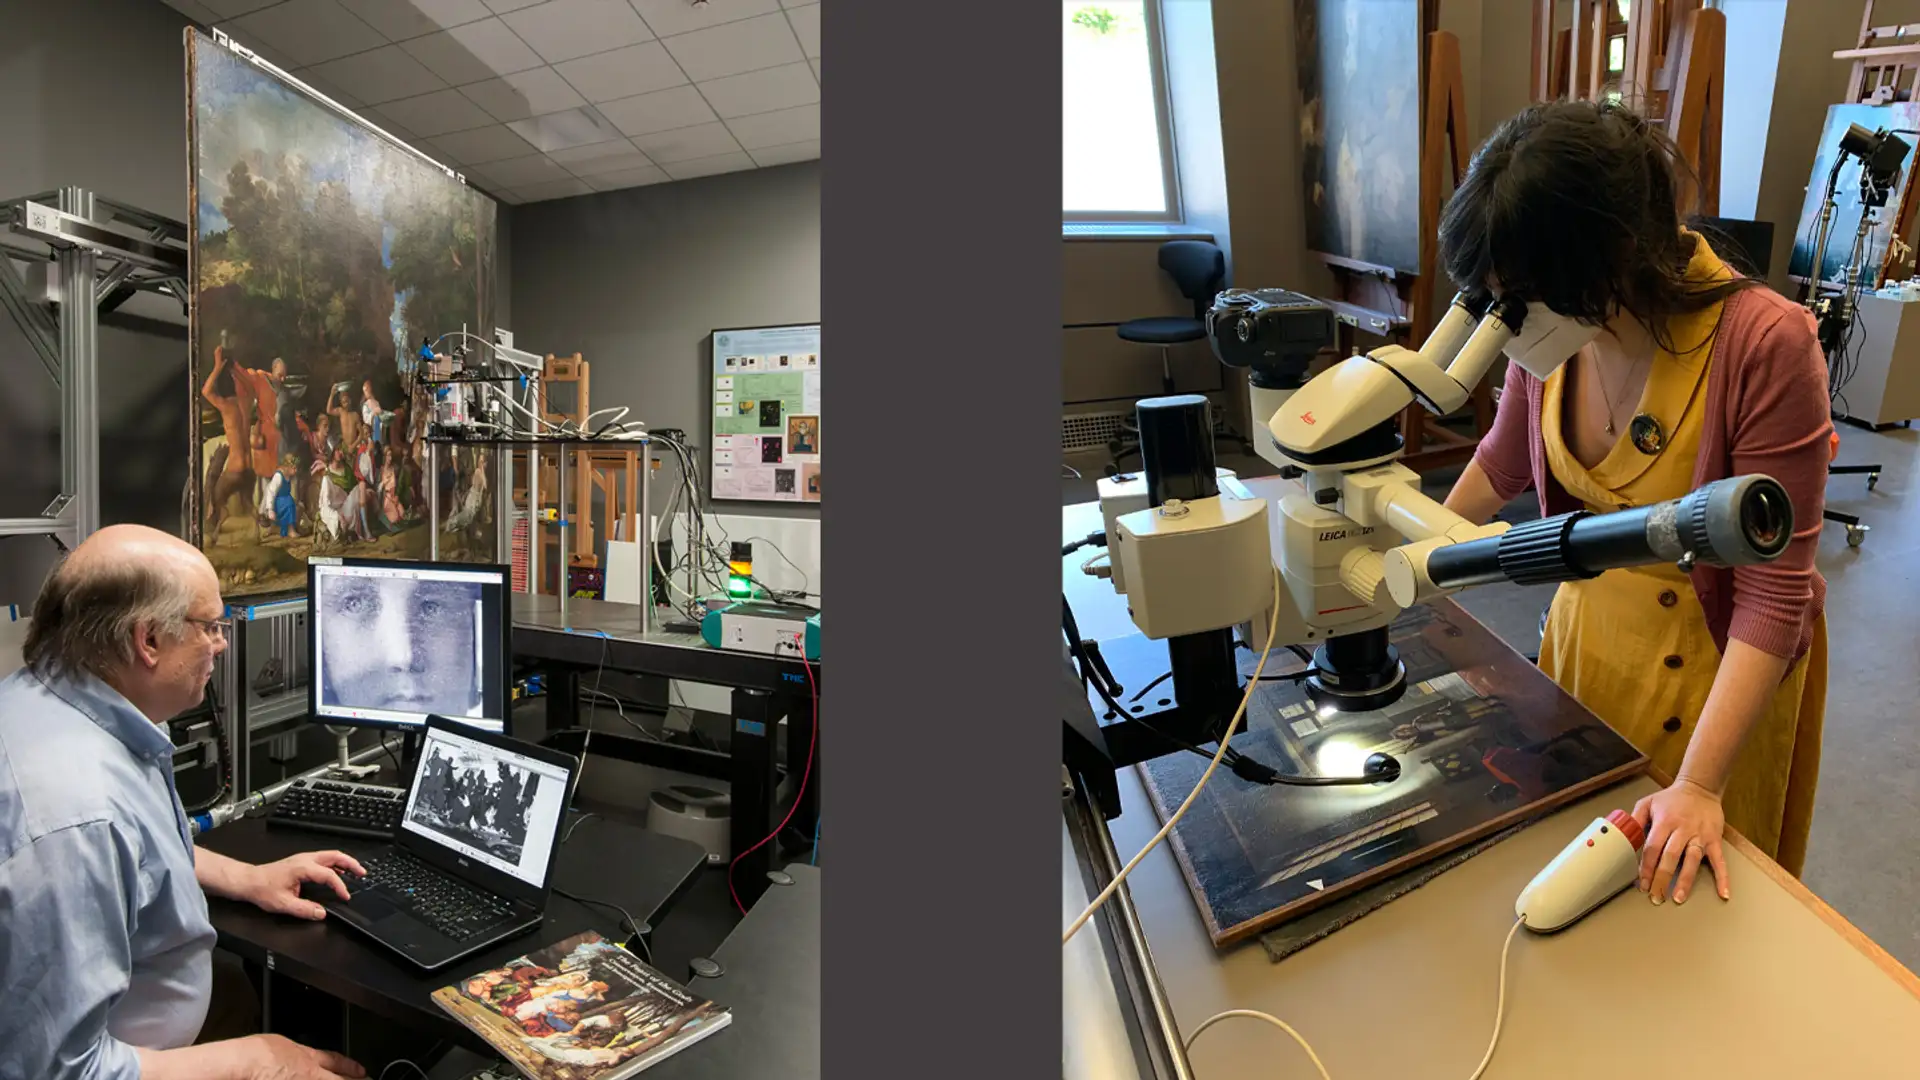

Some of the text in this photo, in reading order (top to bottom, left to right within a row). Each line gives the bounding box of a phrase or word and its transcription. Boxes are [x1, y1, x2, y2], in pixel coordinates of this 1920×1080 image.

[1319, 530, 1347, 541] LEICA
[616, 955, 631, 965] The
[658, 981, 673, 990] the
[671, 989, 693, 1003] Gods
